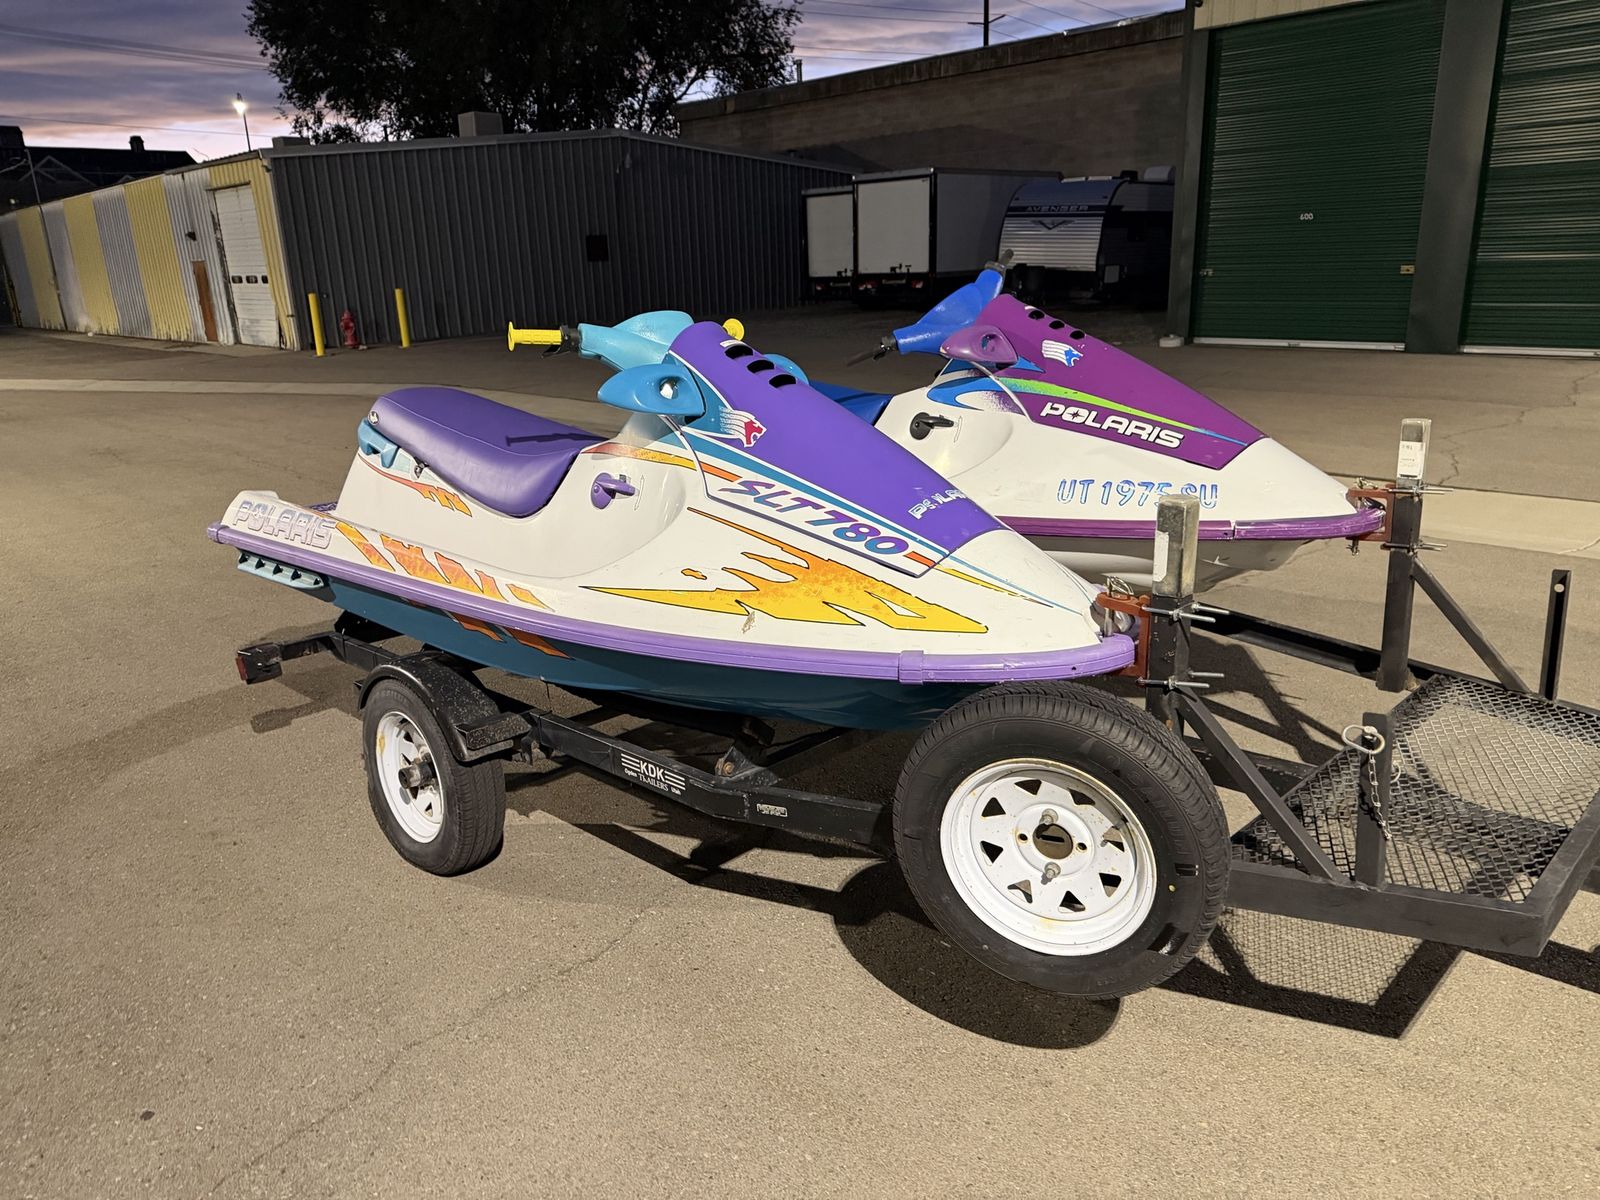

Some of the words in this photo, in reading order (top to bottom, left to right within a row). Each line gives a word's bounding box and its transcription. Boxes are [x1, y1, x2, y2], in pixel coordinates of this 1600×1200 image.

[1026, 205, 1088, 213] AVENGER
[1040, 402, 1185, 448] POLARIS
[1057, 479, 1094, 504] UT
[1101, 480, 1172, 507] 1975
[233, 500, 336, 549] POLARIS
[718, 480, 826, 513] SLT
[805, 509, 910, 555] 780
[640, 760, 665, 782] KDK
